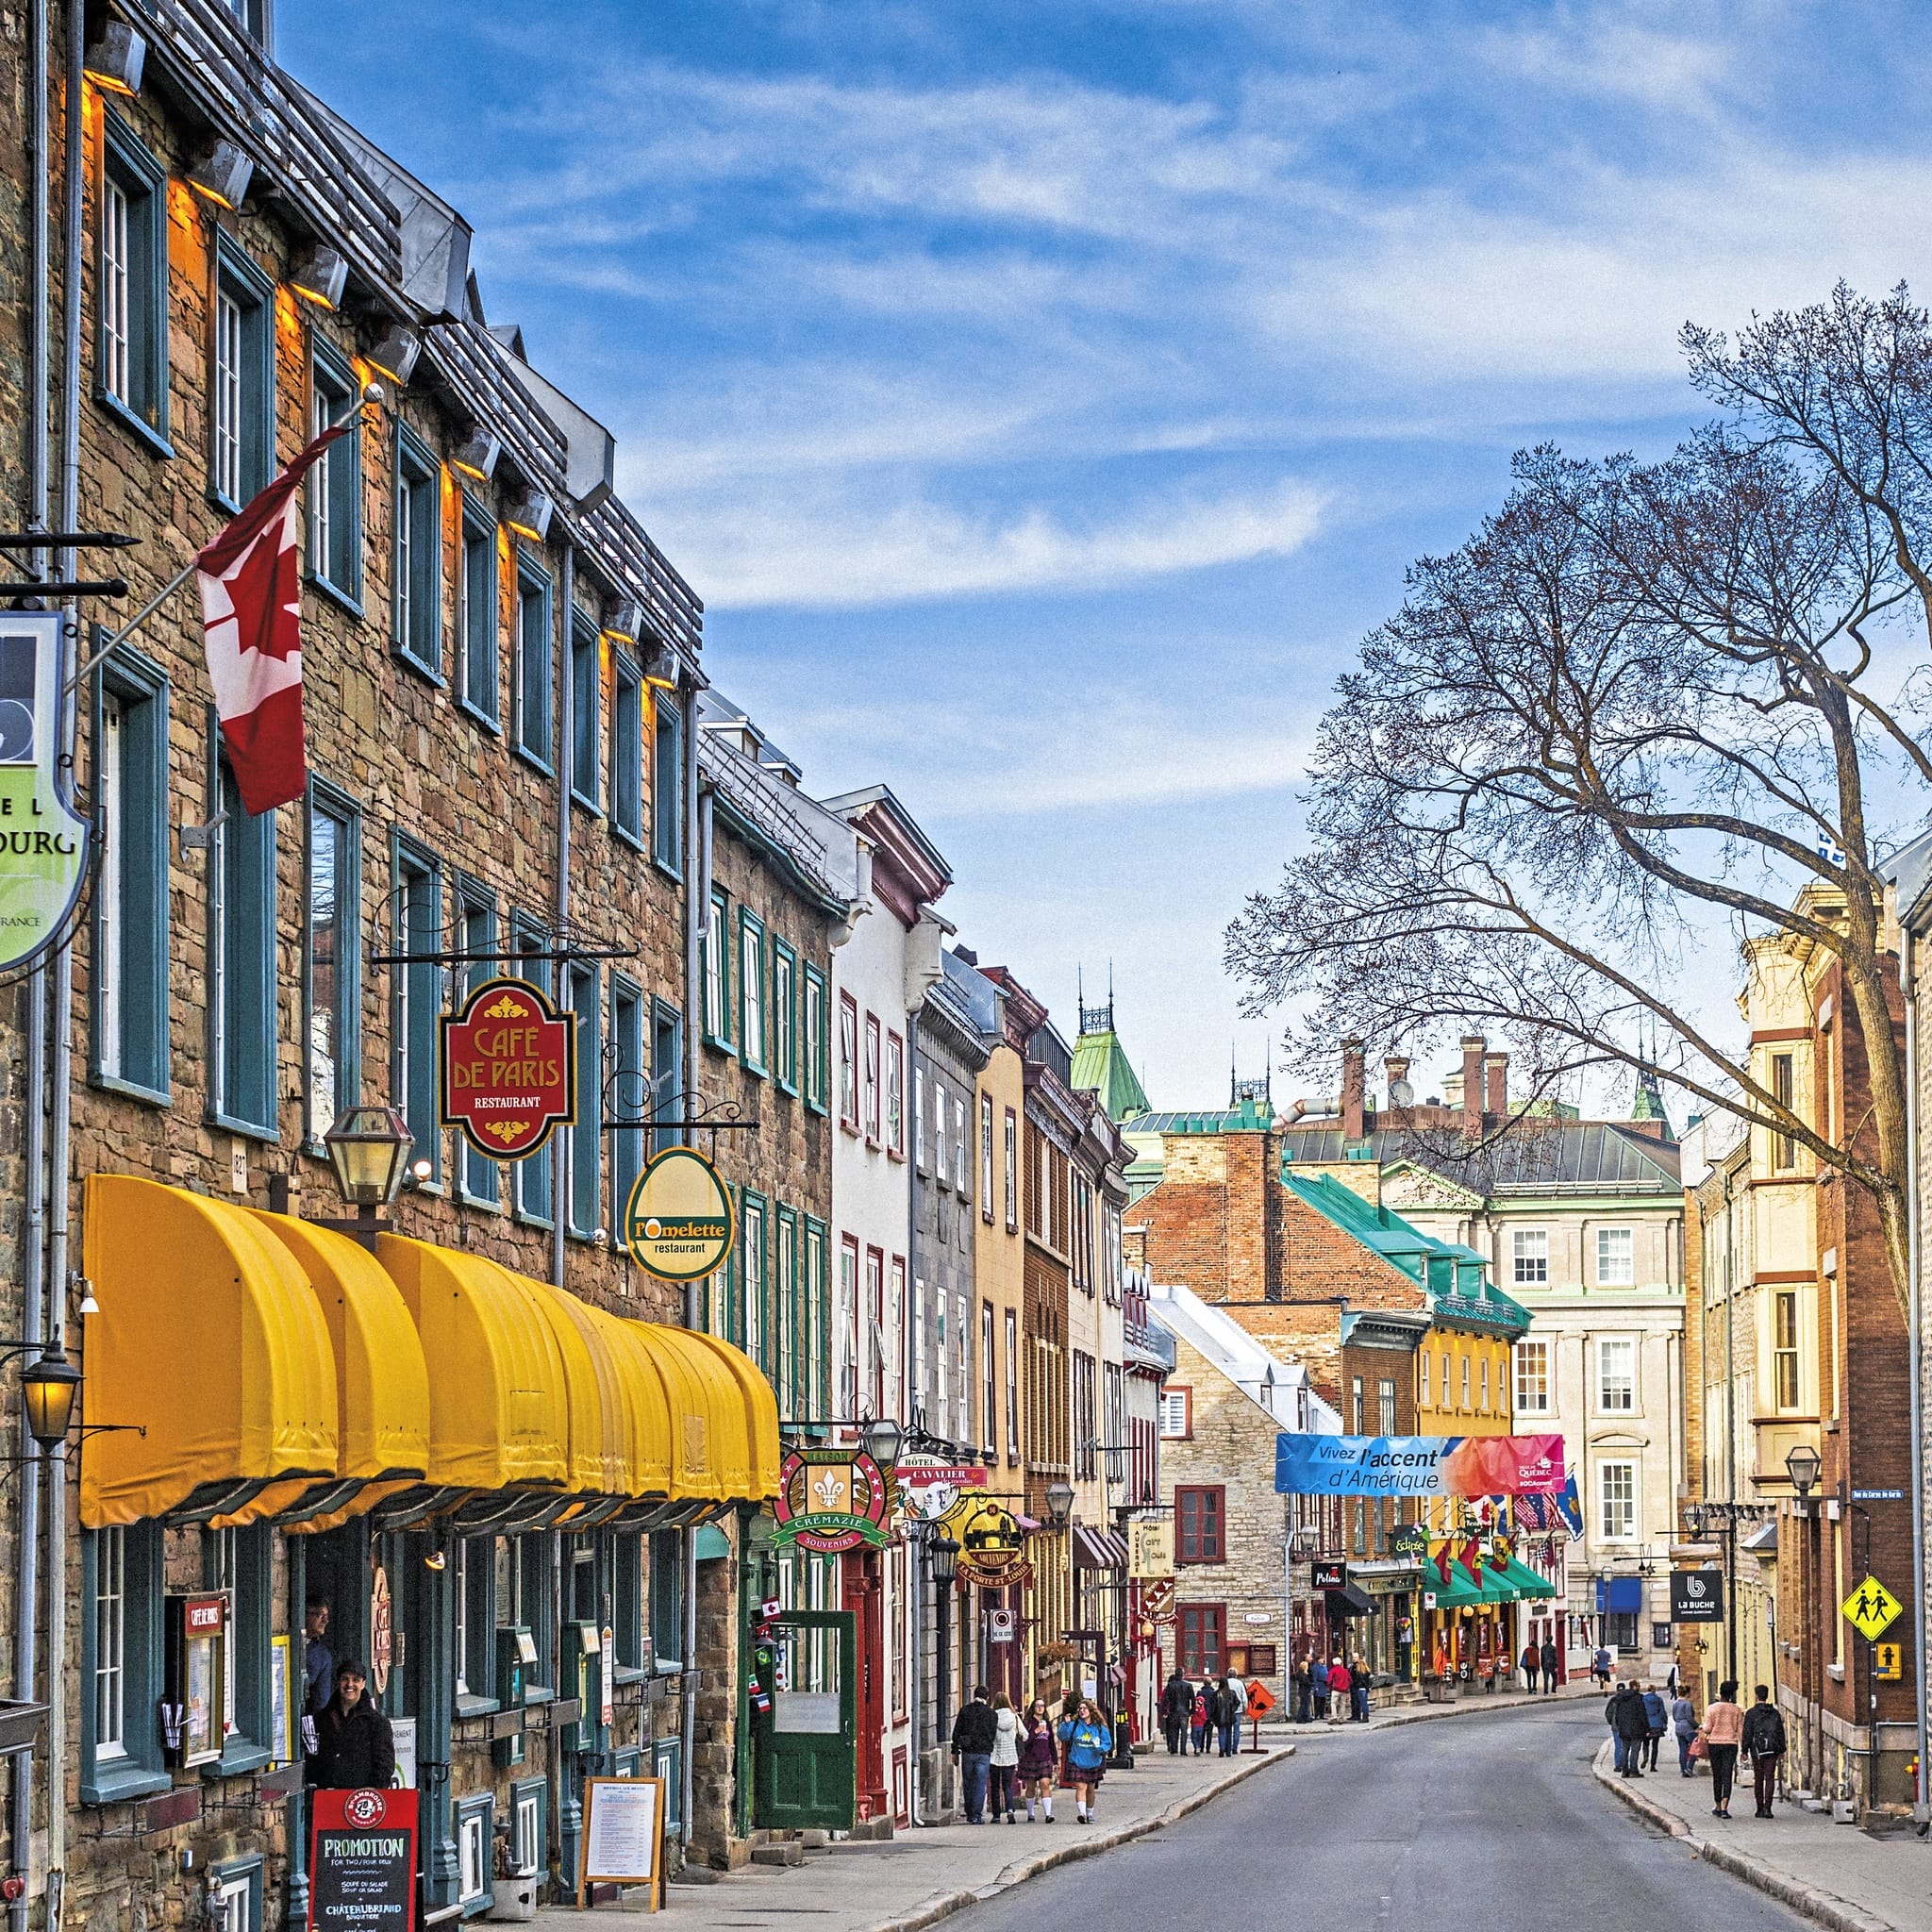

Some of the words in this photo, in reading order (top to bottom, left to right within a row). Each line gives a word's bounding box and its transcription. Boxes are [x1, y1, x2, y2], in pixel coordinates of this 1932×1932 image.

[474, 1025, 540, 1058] CAFÉ
[454, 1061, 486, 1088] DE
[491, 1059, 560, 1087] PARIS
[475, 1096, 541, 1108] RESTAURANT
[655, 1242, 706, 1253] restaurant
[807, 1452, 848, 1461] MAISON
[905, 1457, 936, 1466] HÔTEL
[1320, 1446, 1356, 1459] Vivez
[1359, 1447, 1439, 1467] l'accent
[912, 1470, 966, 1478] CAVALIER
[1329, 1470, 1439, 1492] d'Amérique
[794, 1515, 863, 1528] CRÉMAZIE
[805, 1537, 854, 1548] SOUVENIRS
[978, 1553, 1009, 1565] SOUVENIRS
[958, 1564, 969, 1575] LA
[968, 1572, 994, 1585] PORTE
[1316, 1573, 1341, 1586] Polina
[324, 1838, 405, 1857] PROMOTION
